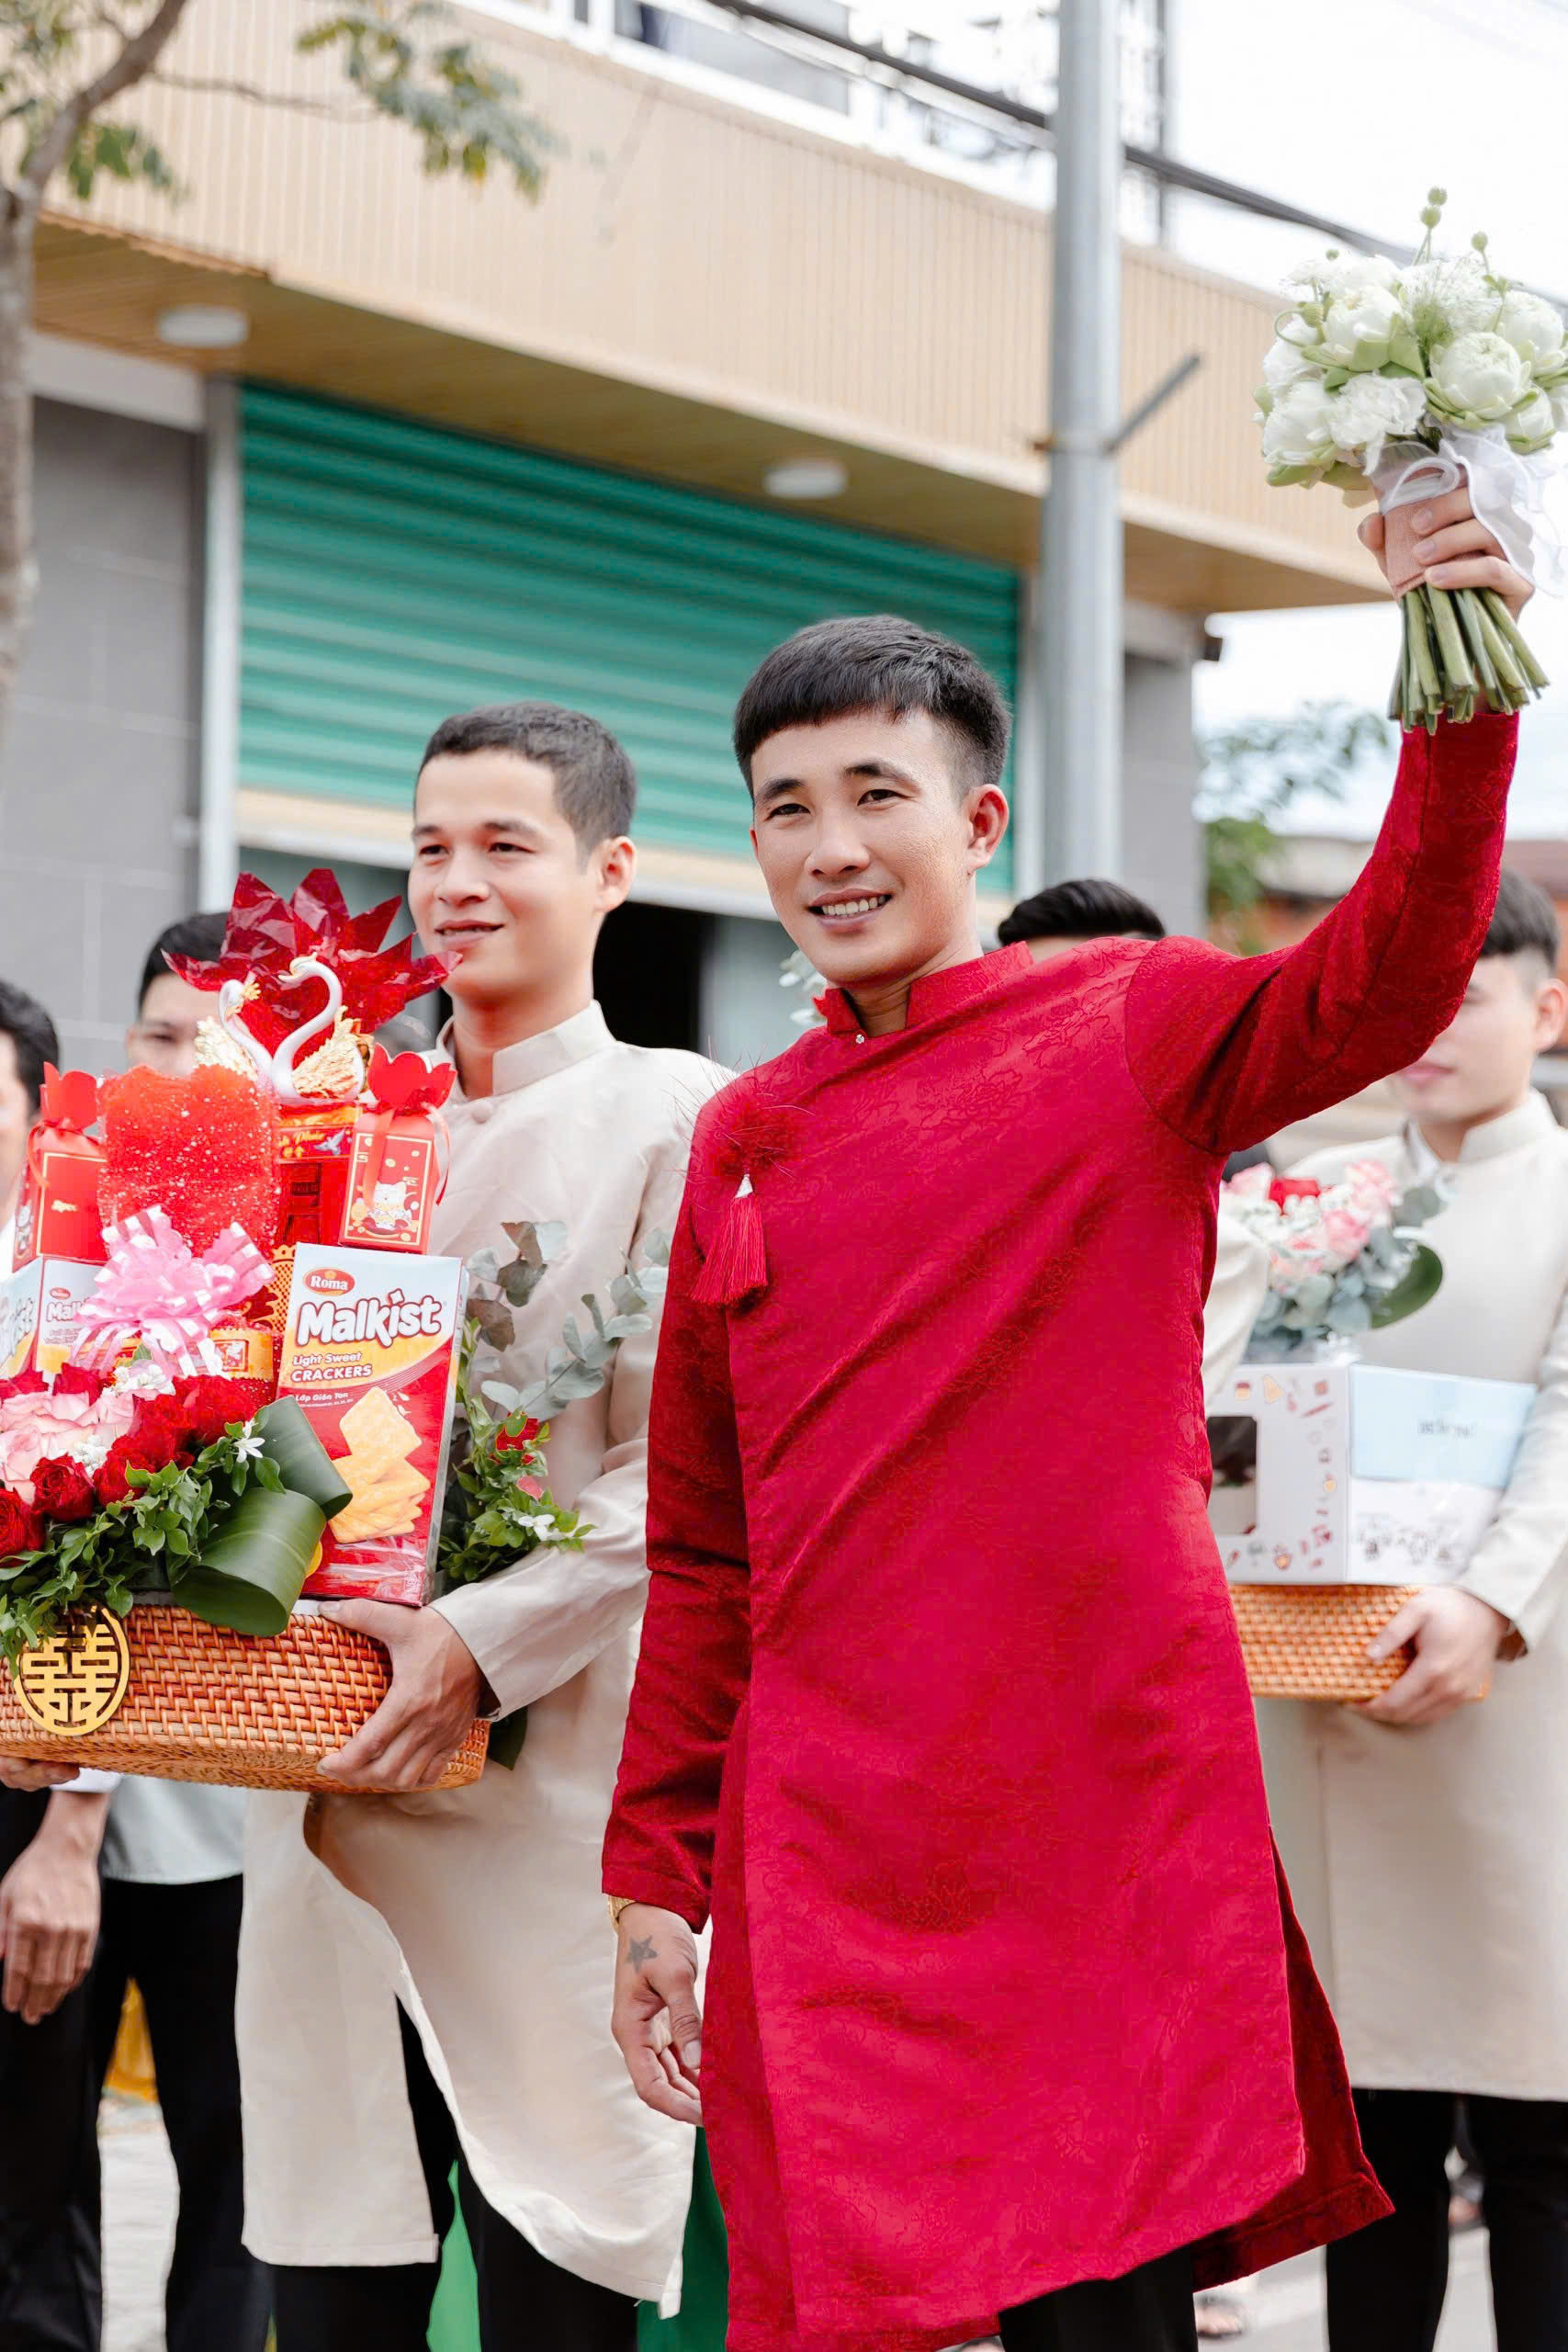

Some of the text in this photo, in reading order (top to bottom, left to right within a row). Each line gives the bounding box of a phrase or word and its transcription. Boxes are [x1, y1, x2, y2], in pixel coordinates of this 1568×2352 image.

[310, 1275, 348, 1290] Roma
[296, 1288, 442, 1348] Malkist
[292, 1351, 362, 1367] Light Sweet
[291, 1364, 372, 1382] CRACKERS
